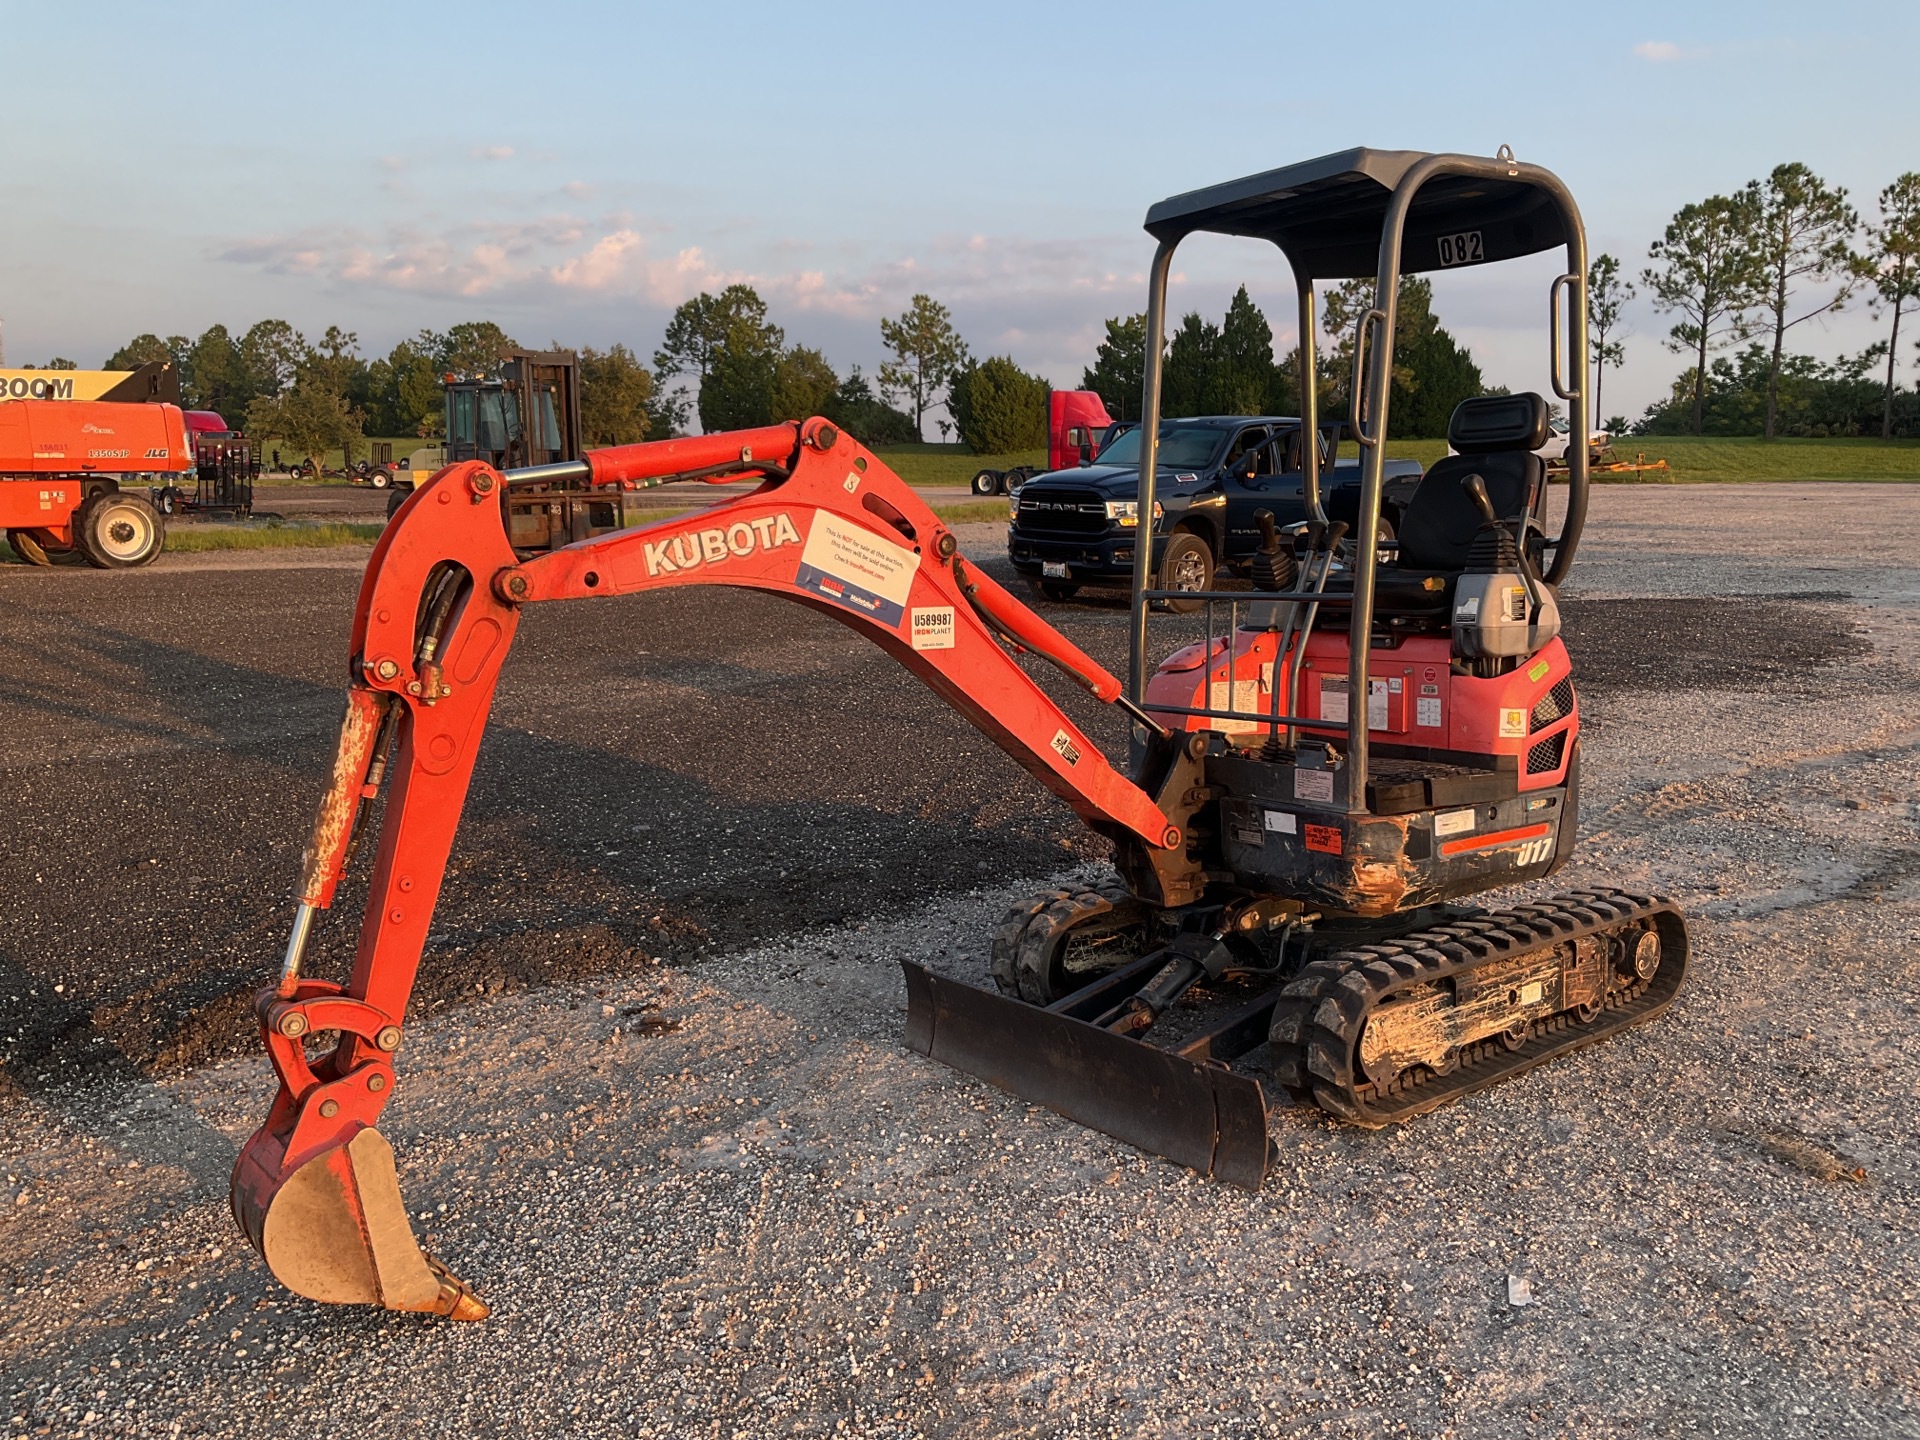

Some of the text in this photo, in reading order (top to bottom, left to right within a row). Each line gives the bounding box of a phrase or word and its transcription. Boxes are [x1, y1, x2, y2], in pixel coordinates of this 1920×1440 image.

[1440, 232, 1482, 264] 082
[89, 449, 130, 458] 1350SJP
[144, 449, 168, 458] JLG
[1040, 502, 1077, 511] RAM
[643, 513, 801, 576] KUBOTA
[826, 527, 836, 537] This
[842, 534, 853, 544] NOT
[860, 544, 870, 552] sale
[876, 551, 885, 560] this
[831, 539, 841, 549] this
[842, 544, 853, 554] item
[853, 550, 862, 559] will
[869, 558, 880, 567] sold
[880, 563, 895, 573] online
[834, 553, 850, 565] Check
[914, 613, 952, 627] U589987
[1516, 837, 1553, 867] U17
